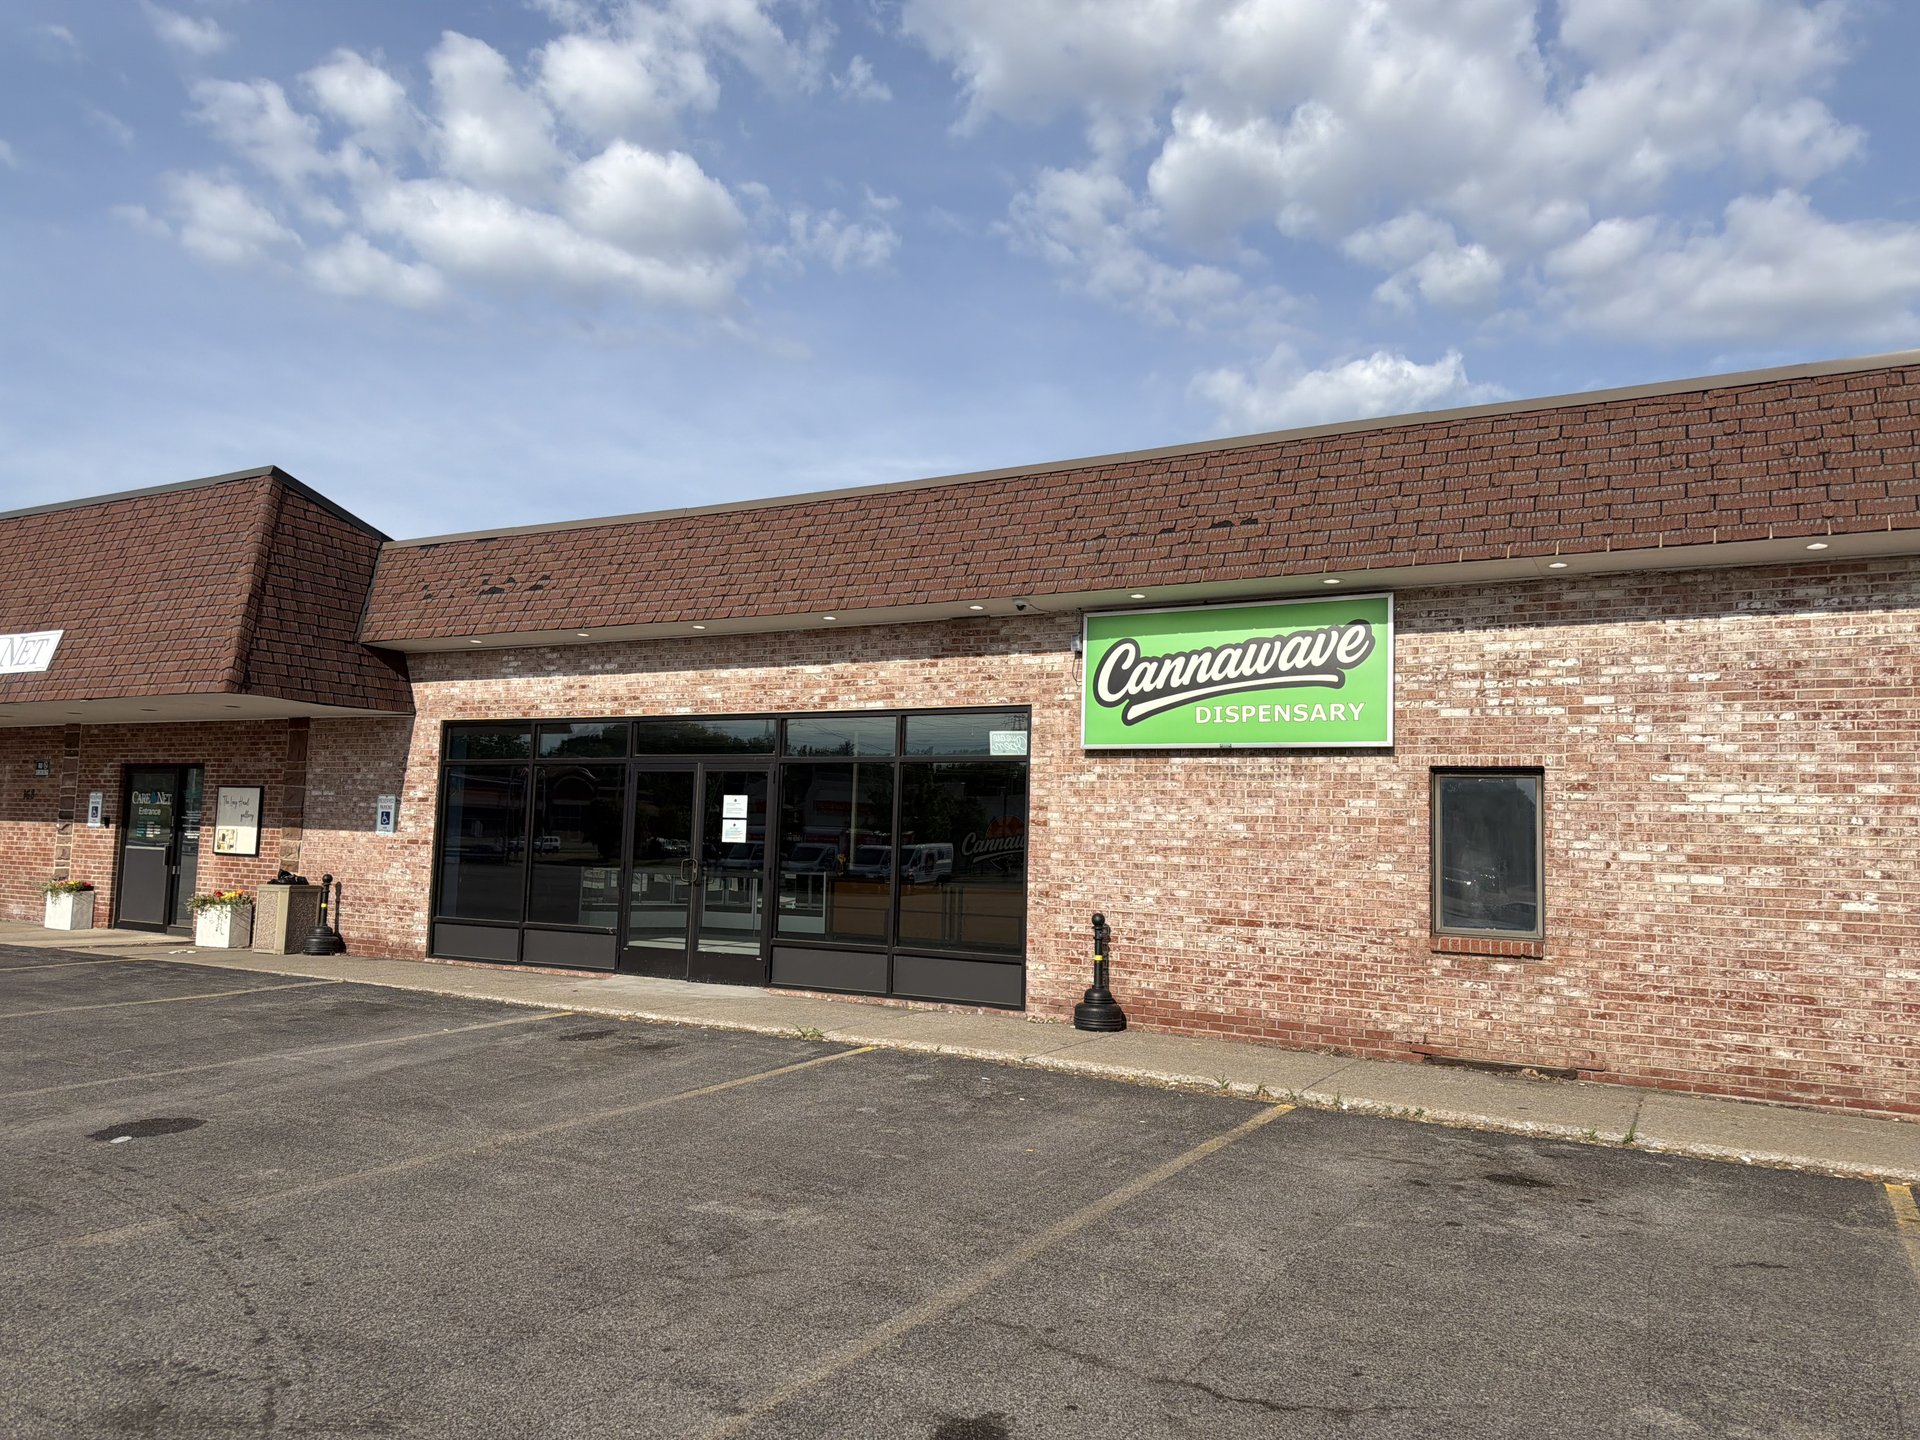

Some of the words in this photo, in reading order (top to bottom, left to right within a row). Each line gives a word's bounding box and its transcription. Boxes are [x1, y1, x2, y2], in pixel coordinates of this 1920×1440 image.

[0, 636, 51, 667] NET
[1097, 623, 1371, 703] Cannawave
[1195, 702, 1366, 724] DISPENSARY
[131, 791, 151, 805] CARE
[156, 792, 173, 805] NET
[138, 807, 161, 815] Entrance
[961, 832, 1025, 856] Cannaw
